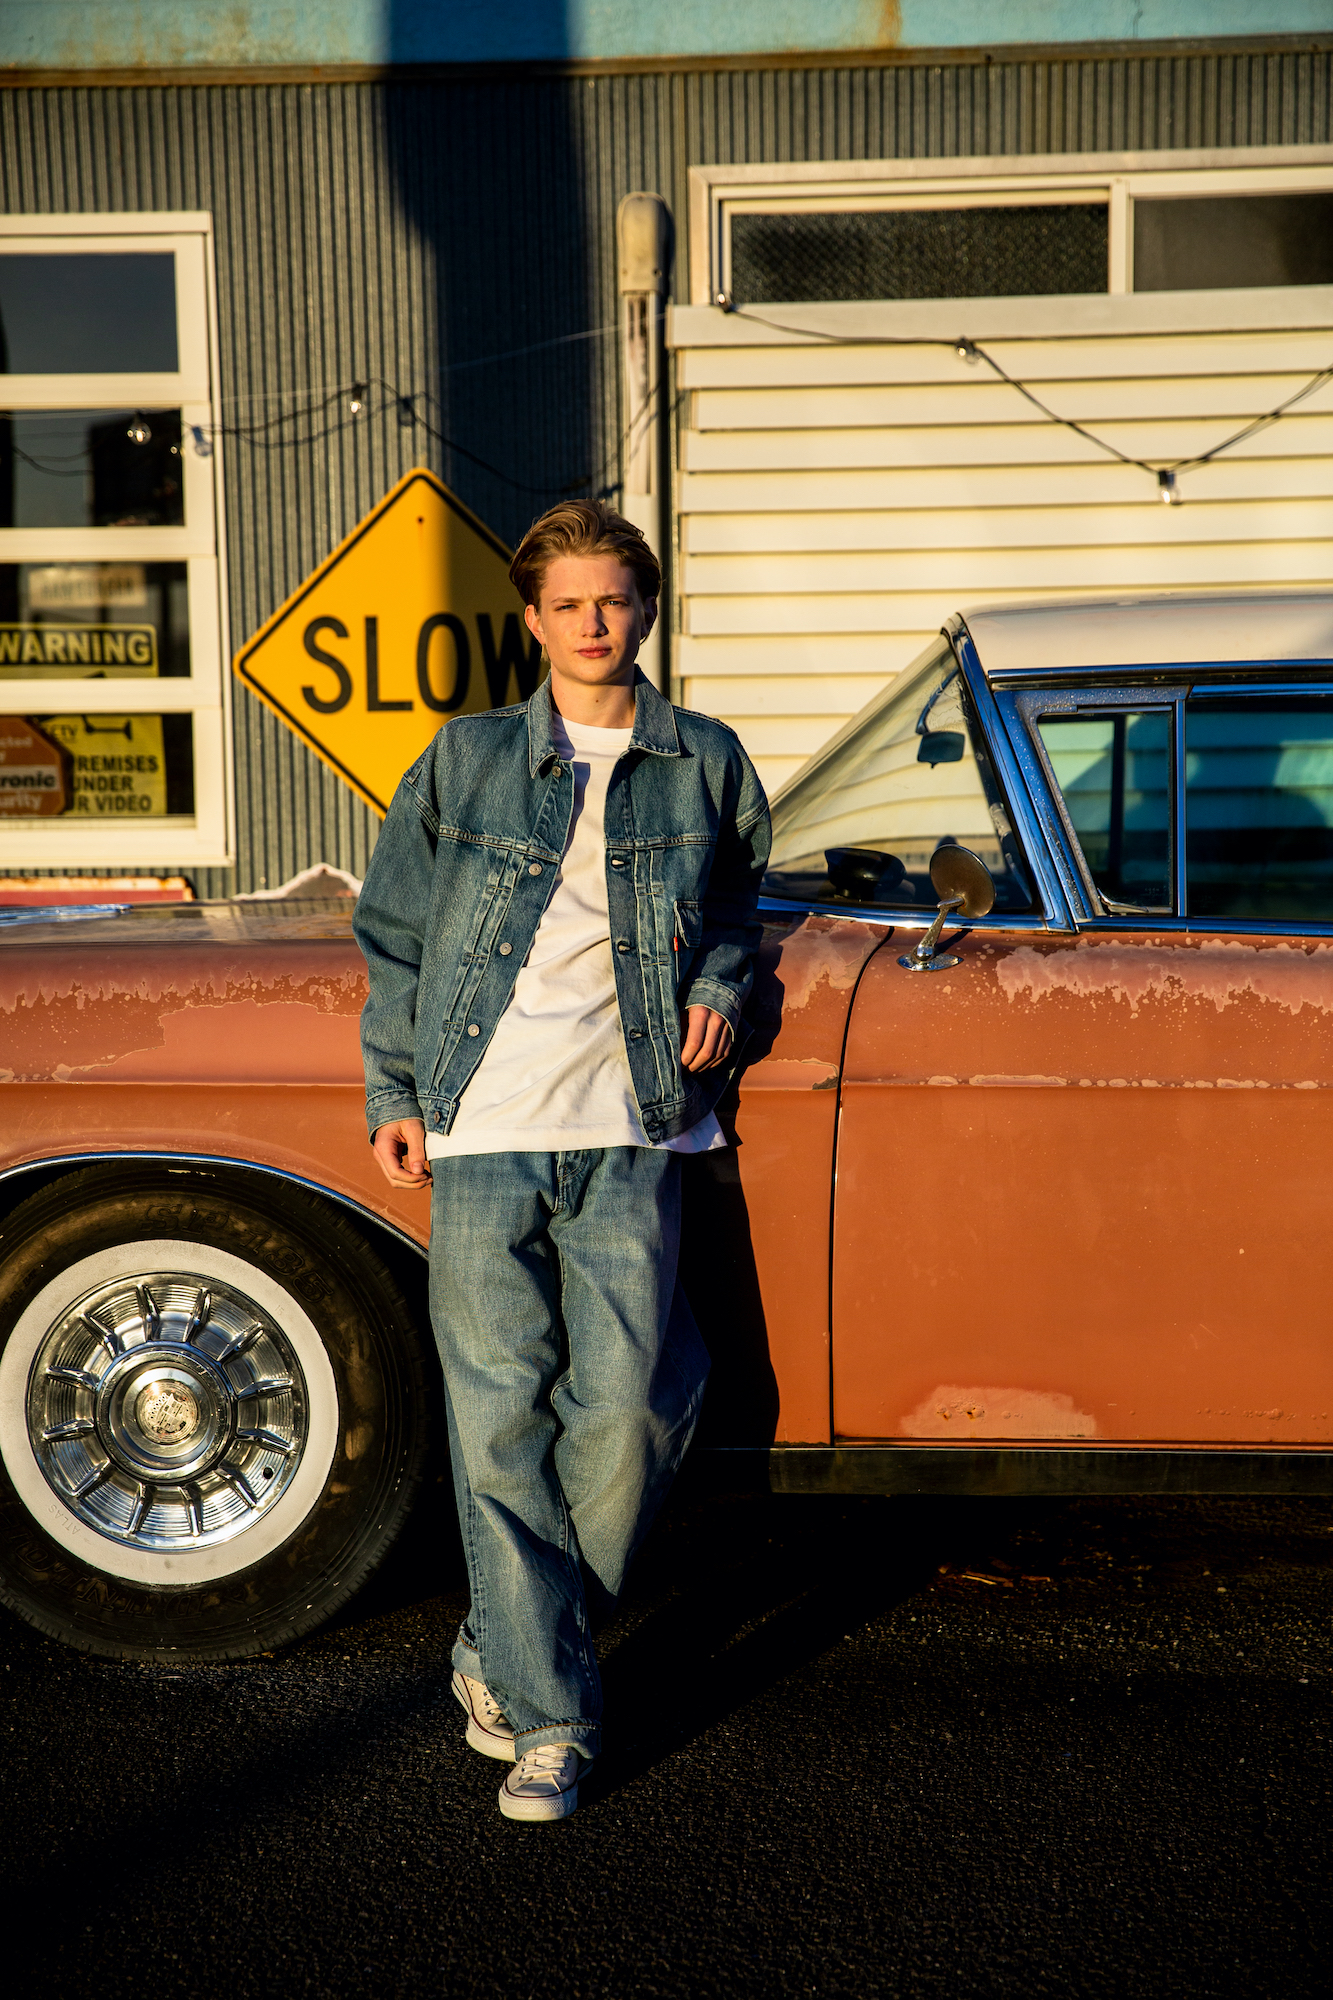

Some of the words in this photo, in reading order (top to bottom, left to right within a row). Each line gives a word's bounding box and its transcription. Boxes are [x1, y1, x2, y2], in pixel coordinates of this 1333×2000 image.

[0, 631, 151, 664] WARNING
[301, 612, 542, 715] SLOW
[75, 754, 159, 773] REMISES
[94, 794, 153, 812] VIDEO
[139, 1203, 229, 1235] SP
[240, 1230, 334, 1303] 185
[48, 1504, 81, 1536] ATLAS
